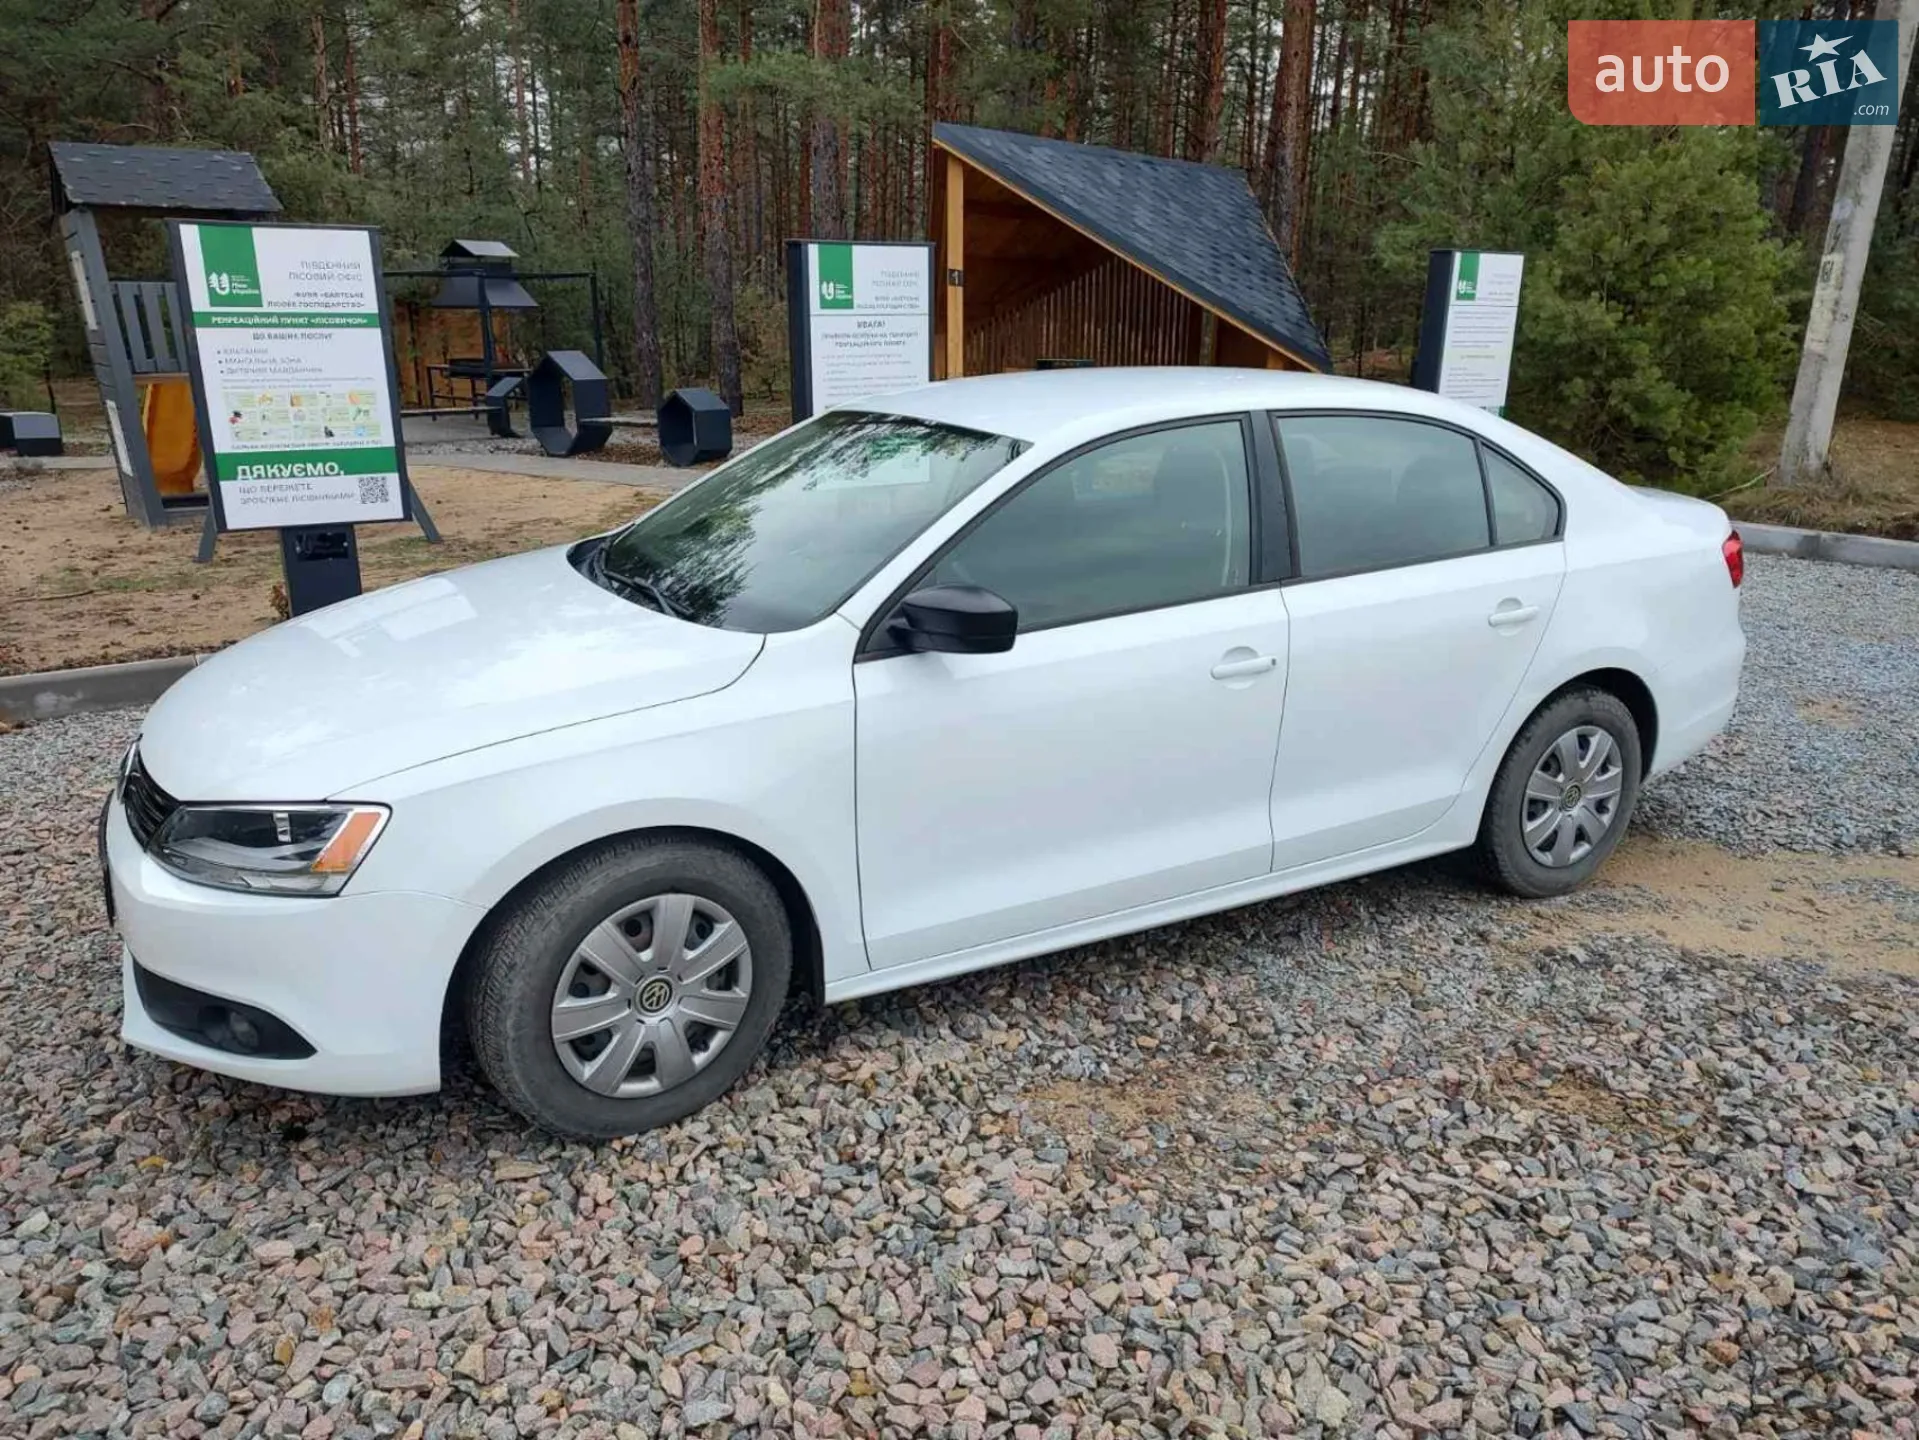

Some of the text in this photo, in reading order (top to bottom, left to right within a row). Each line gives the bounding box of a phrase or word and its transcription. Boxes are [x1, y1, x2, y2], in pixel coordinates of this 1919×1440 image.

[211, 315, 279, 326] РЕКРЕАЦІЙНИЙ
[280, 316, 308, 325] ПУНКТ
[239, 485, 257, 494] ЩО
